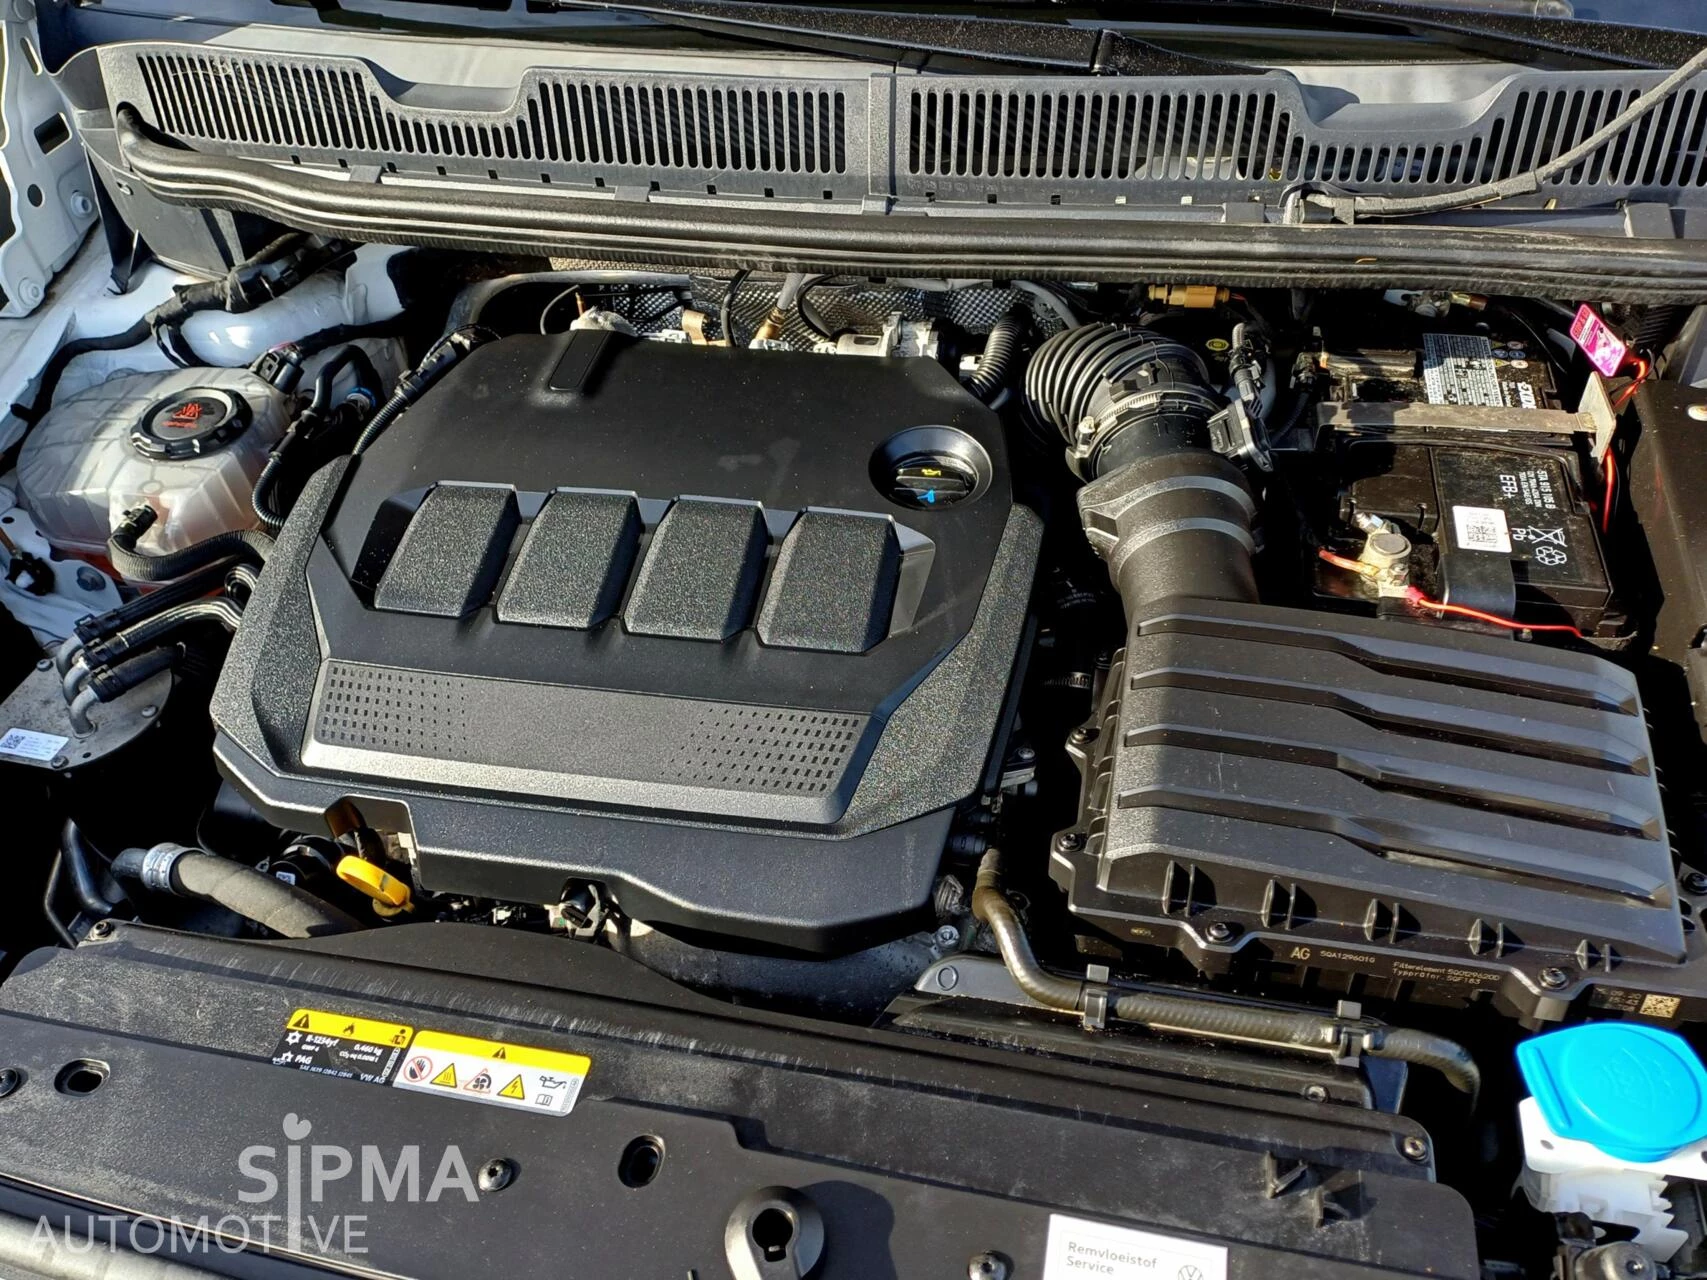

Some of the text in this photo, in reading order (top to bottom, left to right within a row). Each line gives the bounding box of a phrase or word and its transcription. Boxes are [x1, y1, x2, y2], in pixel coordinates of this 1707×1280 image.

[1499, 474, 1519, 499] EFB+
[1511, 527, 1527, 541] Pb
[1290, 946, 1311, 960] AG
[306, 1034, 340, 1048] R-1234yf
[294, 1055, 313, 1065] PAG
[360, 1072, 374, 1081] VW
[373, 1074, 386, 1084] AG
[1068, 1241, 1159, 1269] Remvloeistof
[1066, 1256, 1114, 1275] Service
